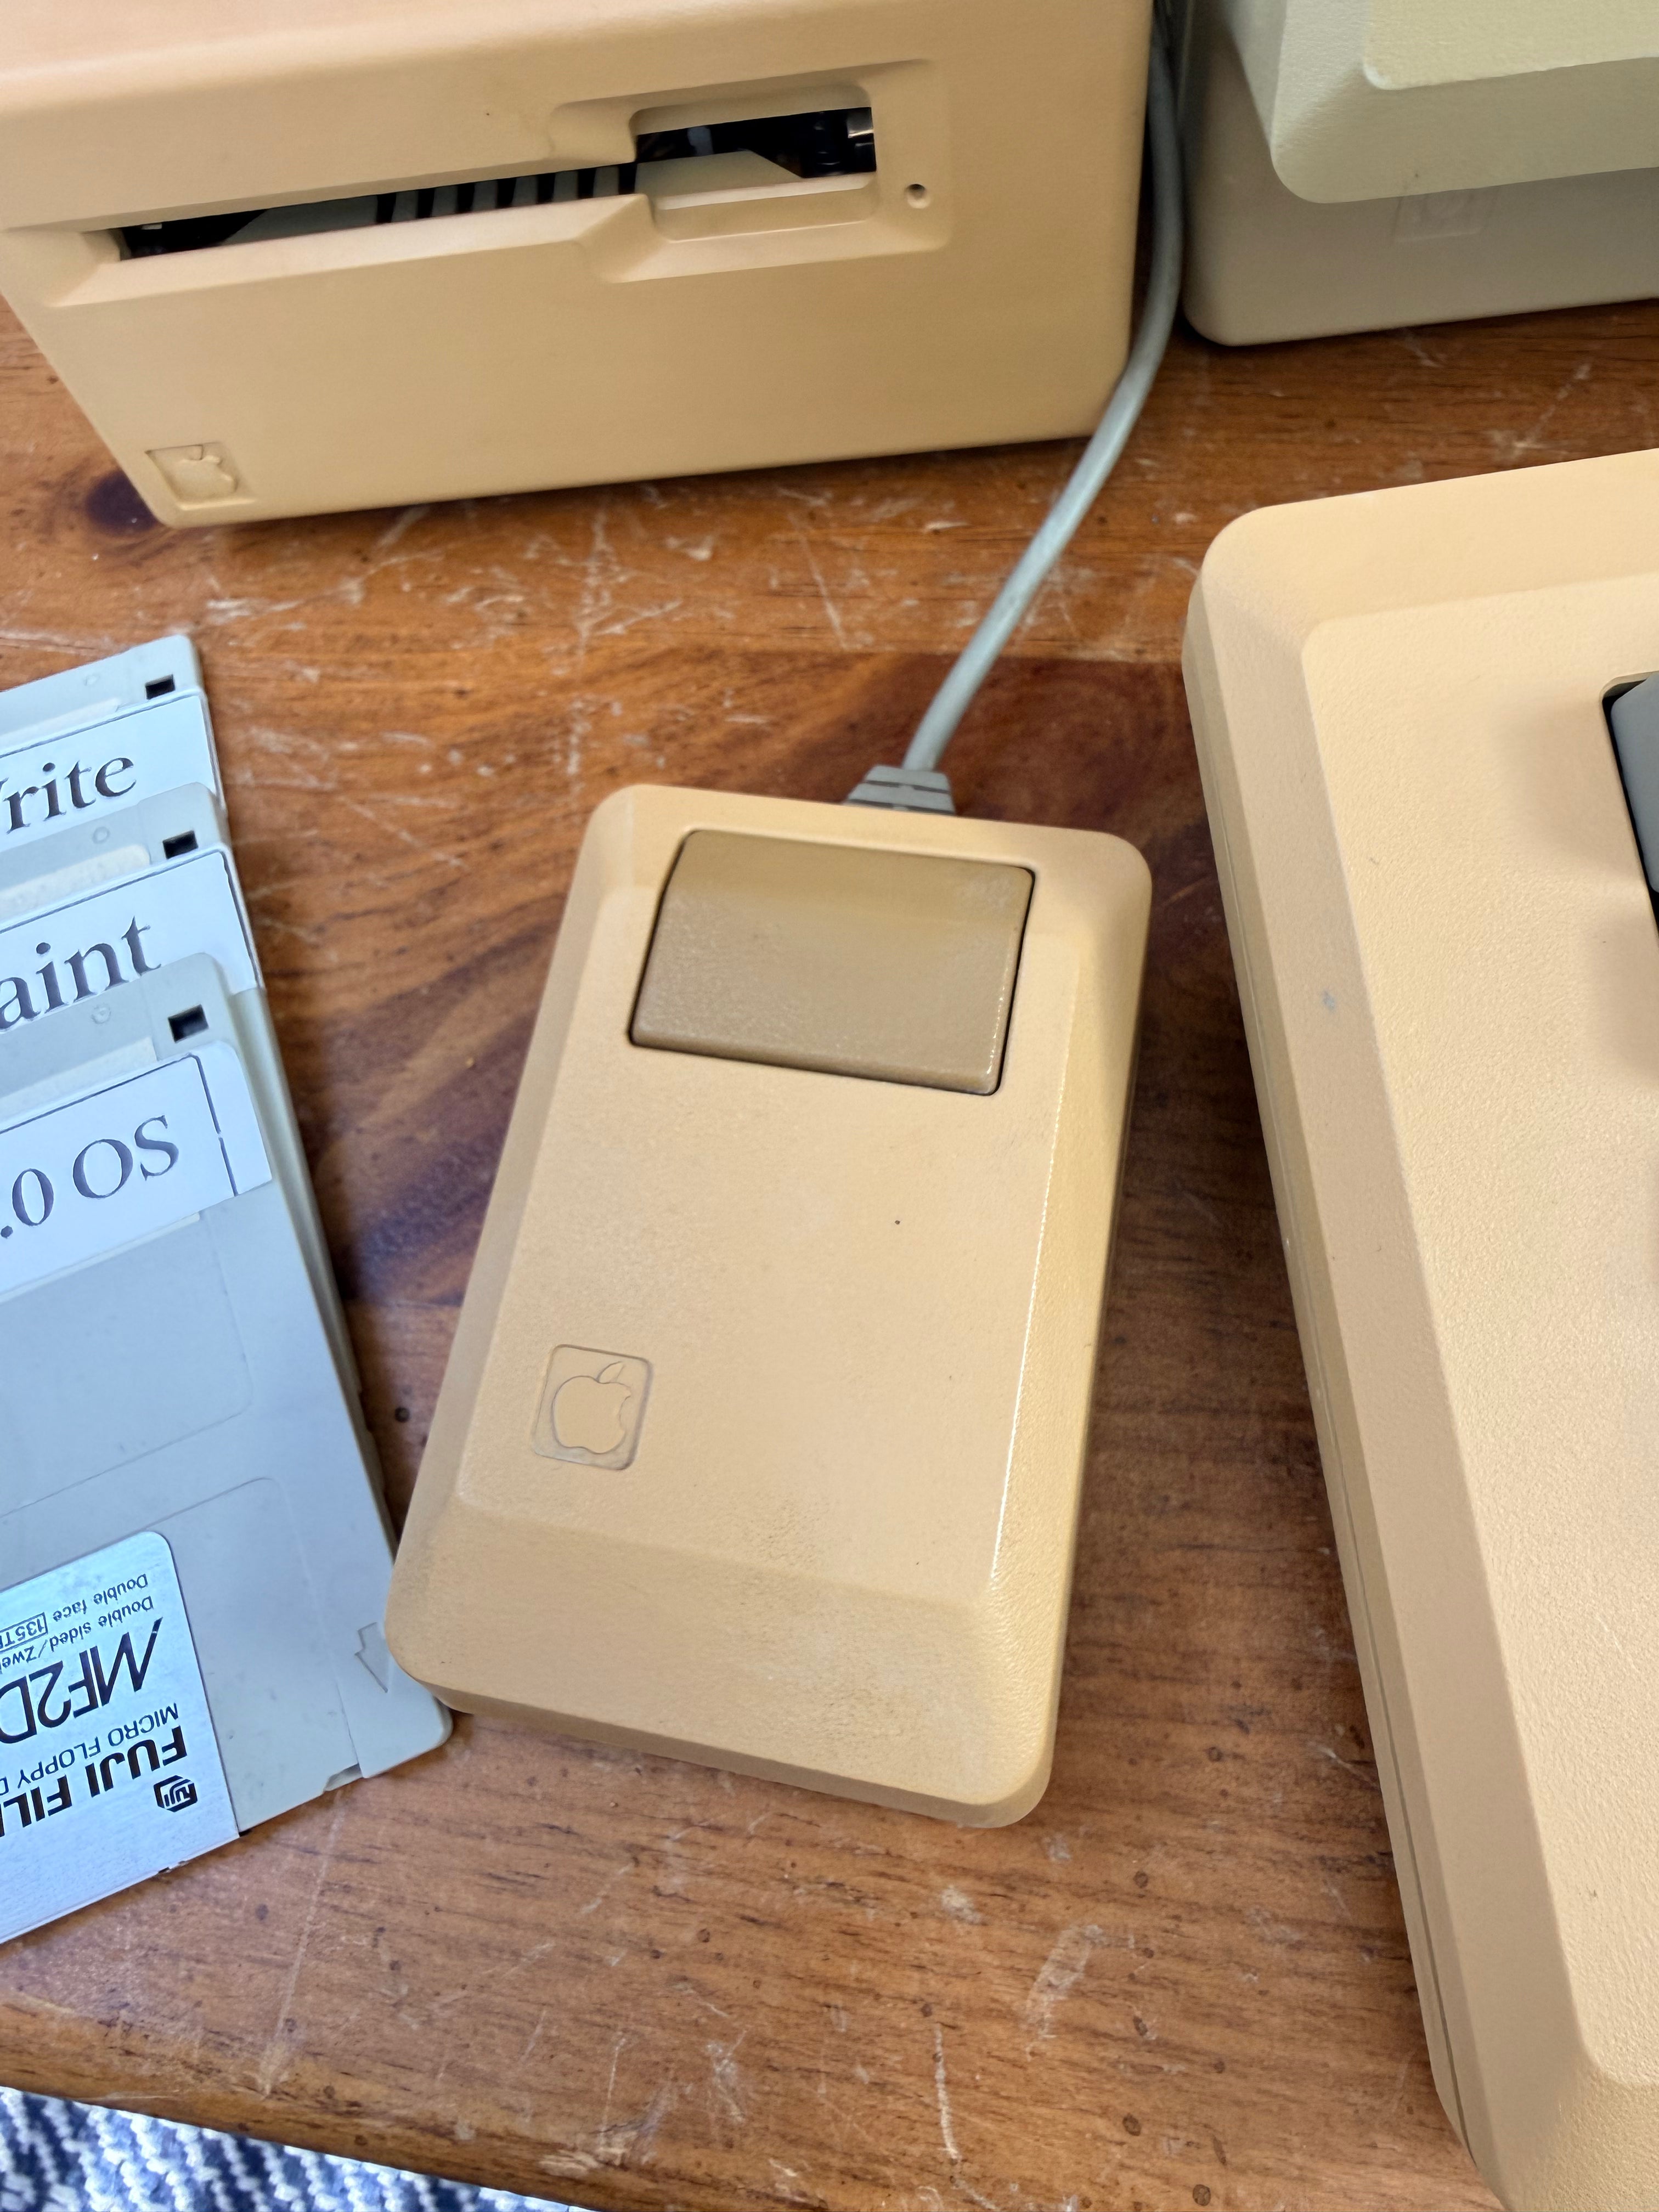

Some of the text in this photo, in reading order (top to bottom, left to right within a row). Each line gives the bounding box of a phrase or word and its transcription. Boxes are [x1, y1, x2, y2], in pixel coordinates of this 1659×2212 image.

[0, 757, 136, 833] rite
[72, 1115, 179, 1199] OS
[52, 1599, 87, 1622] face
[93, 1573, 148, 1605] Double
[98, 1595, 154, 1628] Double
[108, 1702, 178, 1746] MICRO
[0, 1725, 187, 1838] FUJI FIL
[18, 1736, 101, 1789] FLOPPY
